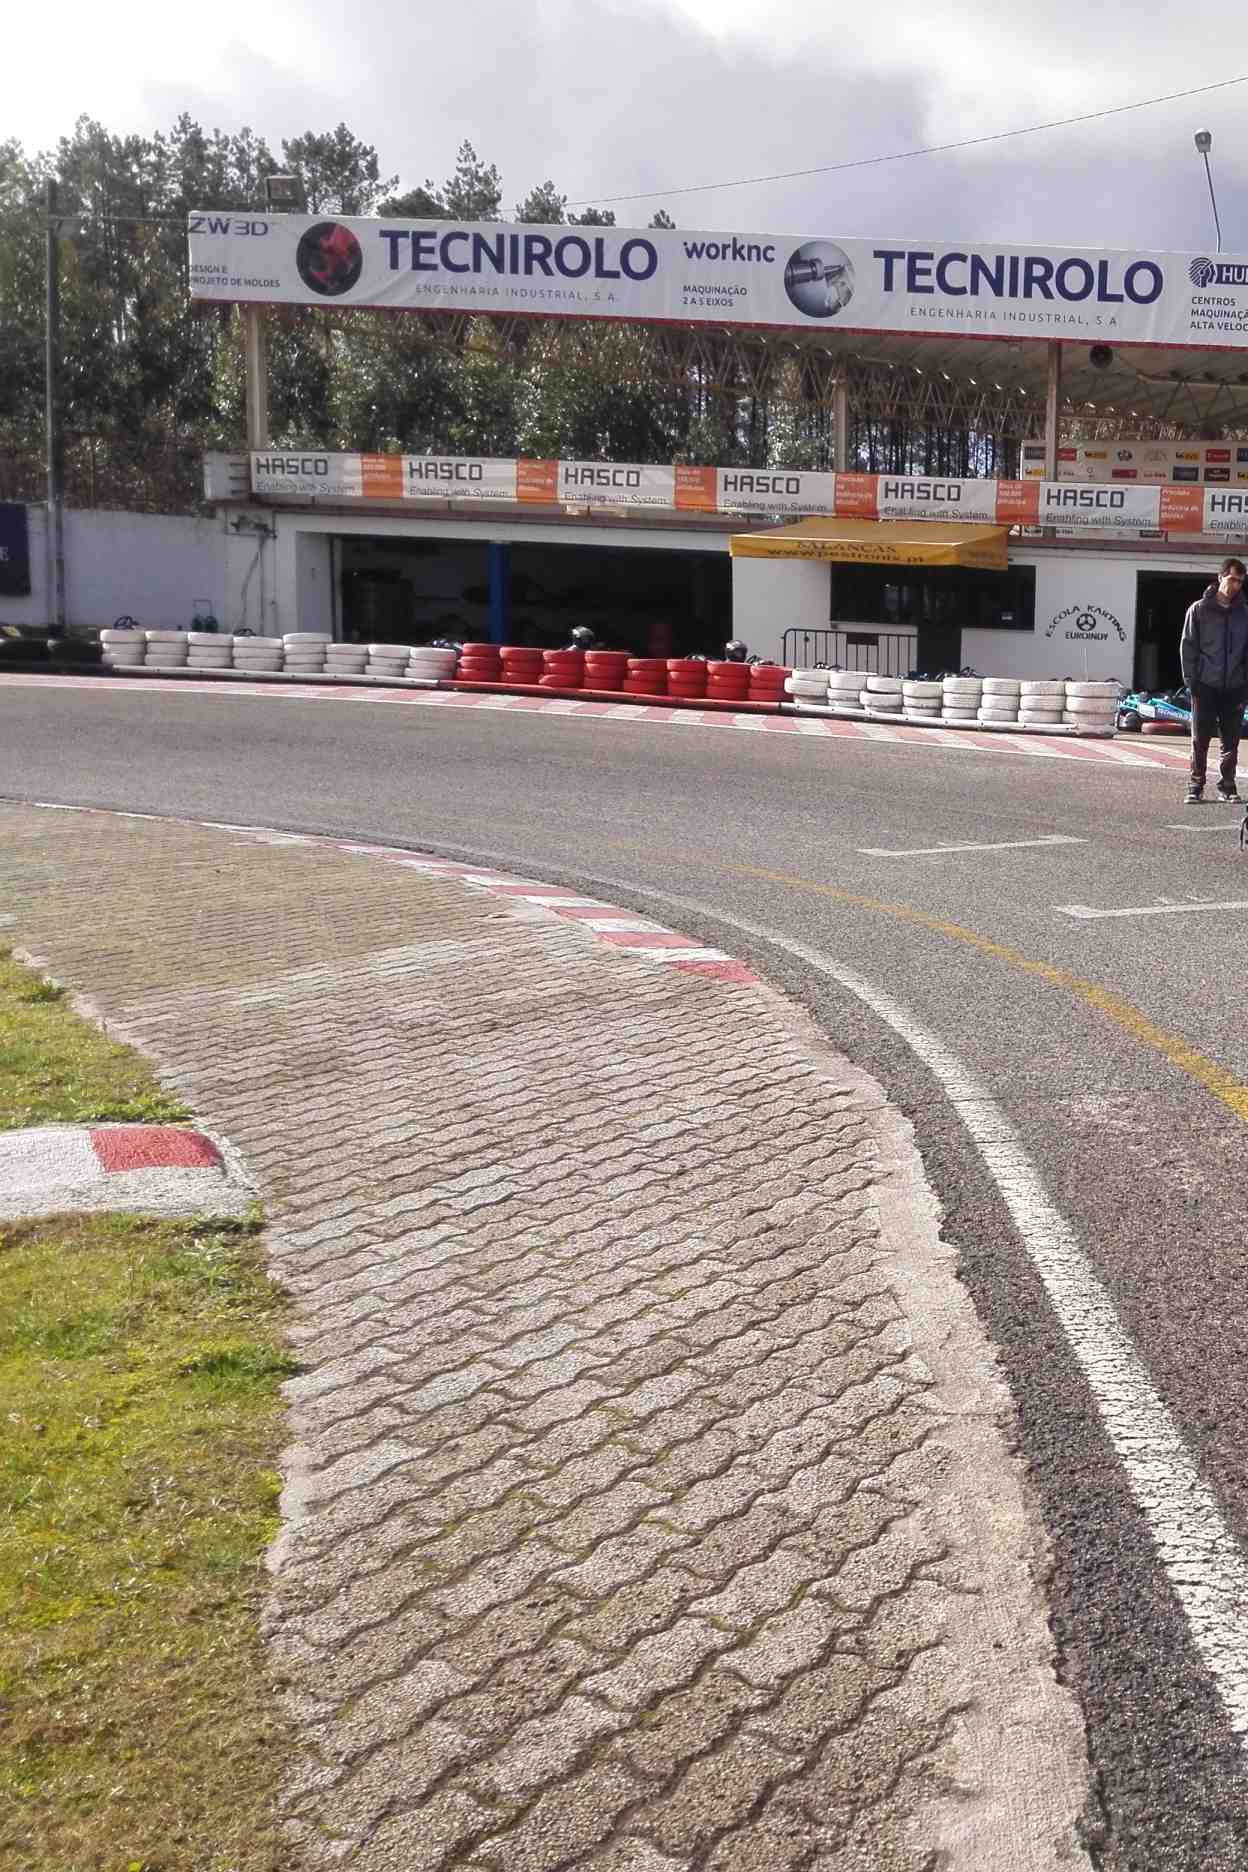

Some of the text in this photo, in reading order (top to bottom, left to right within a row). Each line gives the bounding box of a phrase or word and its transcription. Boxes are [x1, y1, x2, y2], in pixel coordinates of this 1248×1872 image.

[379, 230, 658, 281] TECNIROLO
[683, 236, 775, 263] worknc
[230, 278, 241, 287] DE
[244, 279, 281, 288] MOLDES
[873, 249, 1164, 304] TECNIROLO
[415, 284, 500, 297] ENGENHARIA
[683, 285, 748, 296] MAQUINAÇÃO
[690, 297, 697, 305] A
[706, 298, 734, 307] EIXOS
[1191, 296, 1237, 306] CENTROS
[910, 307, 997, 320] ENGENHARIA
[1190, 321, 1215, 330] ALTA
[255, 458, 329, 476] HASCO
[408, 462, 482, 480] HASCO
[564, 467, 640, 487] HASCO
[724, 474, 800, 494] HASCO
[884, 482, 961, 501] HASCO
[1046, 488, 1125, 508] HASCO
[1045, 604, 1128, 642] ESCOLA KARTING
[1064, 631, 1109, 641] EUROINDY
